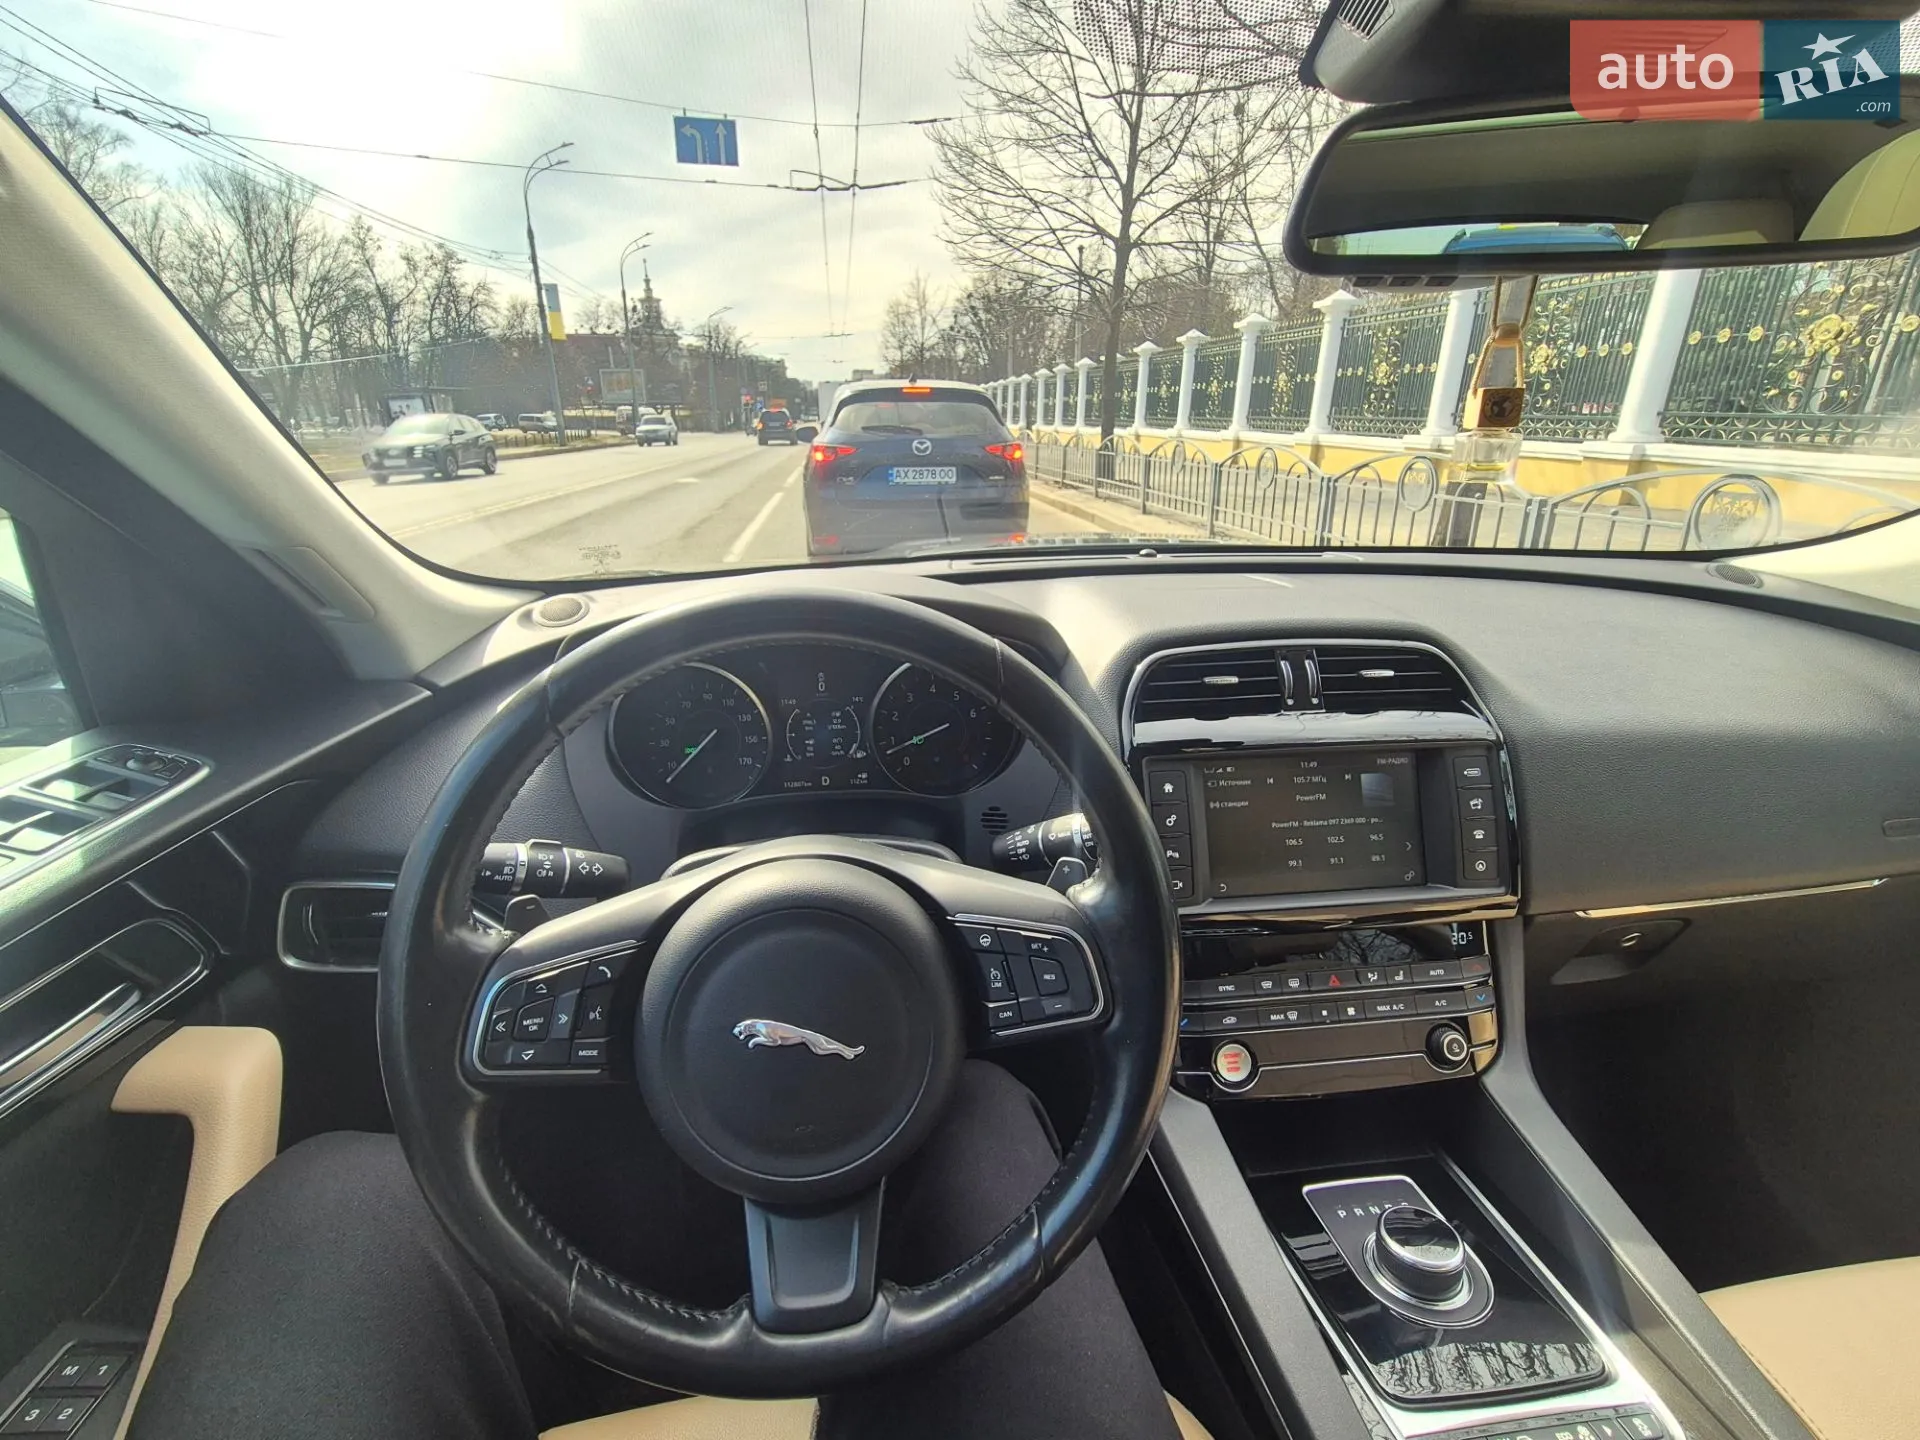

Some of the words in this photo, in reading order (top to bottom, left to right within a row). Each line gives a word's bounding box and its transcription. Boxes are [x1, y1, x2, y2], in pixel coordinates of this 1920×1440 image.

[895, 469, 910, 480] AX
[911, 469, 937, 480] 2878
[818, 681, 826, 691] 0
[929, 684, 936, 693] 4
[907, 692, 913, 702] 3
[953, 691, 960, 701] 5
[738, 714, 752, 722] 130
[891, 711, 899, 721] 2
[970, 708, 977, 718] 6
[890, 736, 895, 745] 1
[667, 761, 677, 770] 10
[903, 756, 910, 766] 0
[821, 776, 830, 786] D
[1293, 776, 1310, 784] 105.7
[1295, 793, 1327, 802] PowerFM
[1285, 838, 1303, 846] 106.5
[1288, 859, 1303, 867] 99.1
[1451, 931, 1474, 945] 20.5
[522, 1017, 544, 1026] MENU
[1337, 1209, 1347, 1219] P
[1353, 1207, 1365, 1216] R
[1368, 1205, 1380, 1215] N
[61, 1365, 80, 1376] M
[97, 1364, 109, 1376] 1
[24, 1408, 41, 1421] 3
[56, 1407, 73, 1420] 2
